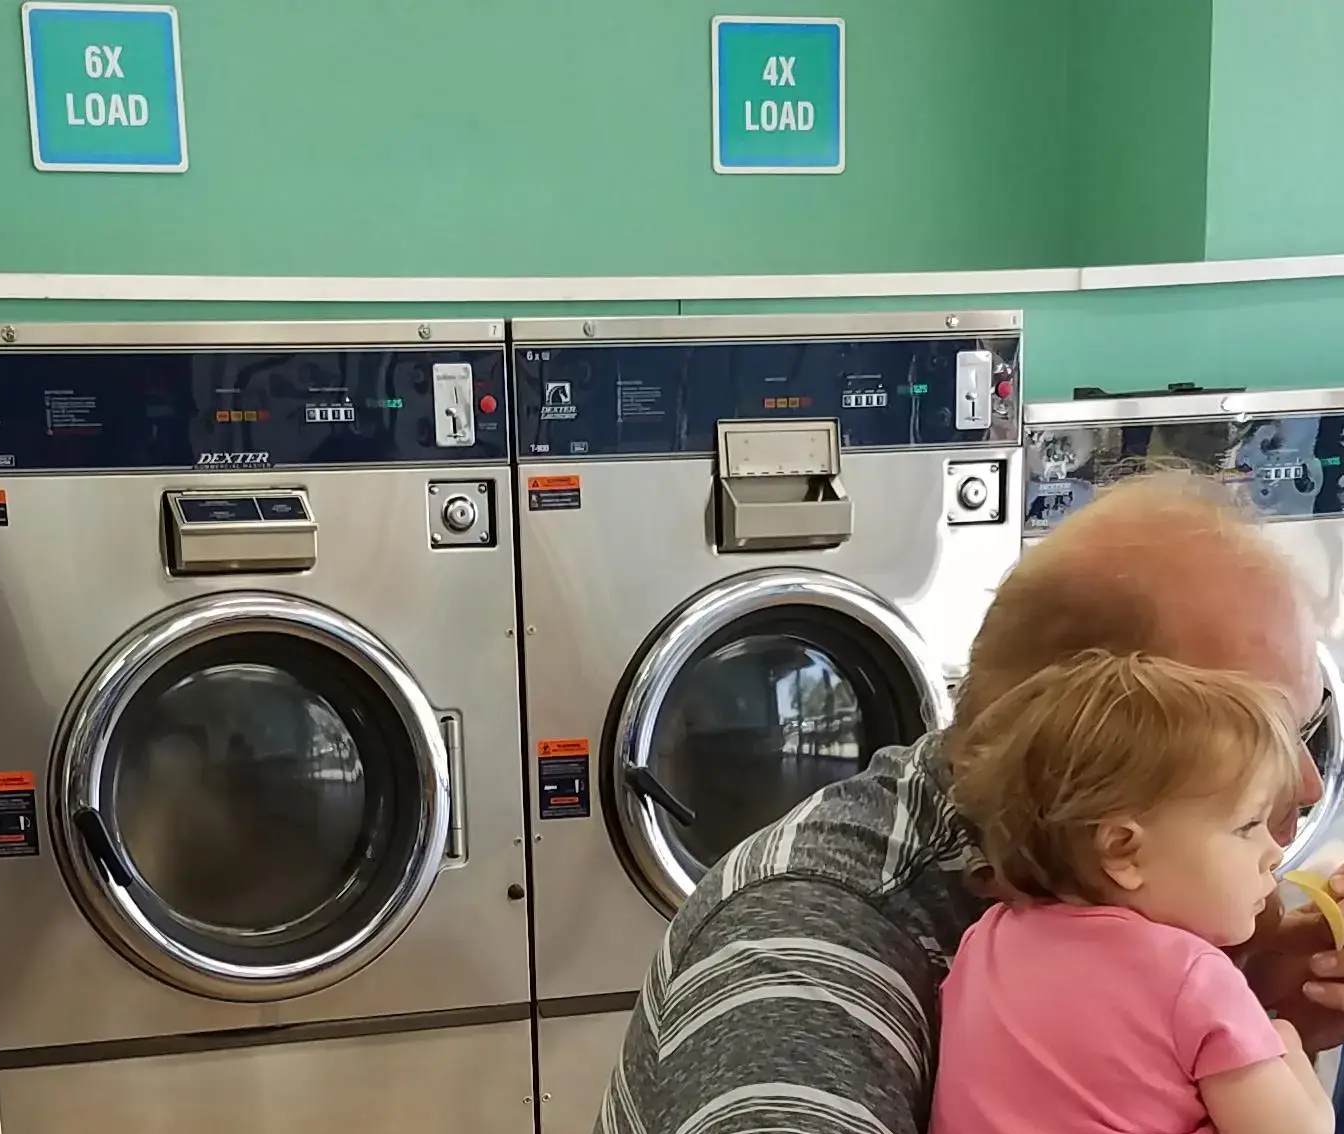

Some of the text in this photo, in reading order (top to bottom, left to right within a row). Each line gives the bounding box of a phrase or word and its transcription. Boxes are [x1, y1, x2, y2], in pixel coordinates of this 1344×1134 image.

[84, 45, 125, 78] 6X
[762, 56, 796, 87] 4X
[65, 92, 149, 126] LOAD
[744, 100, 815, 132] LOAD
[197, 452, 269, 465] DEXTER
